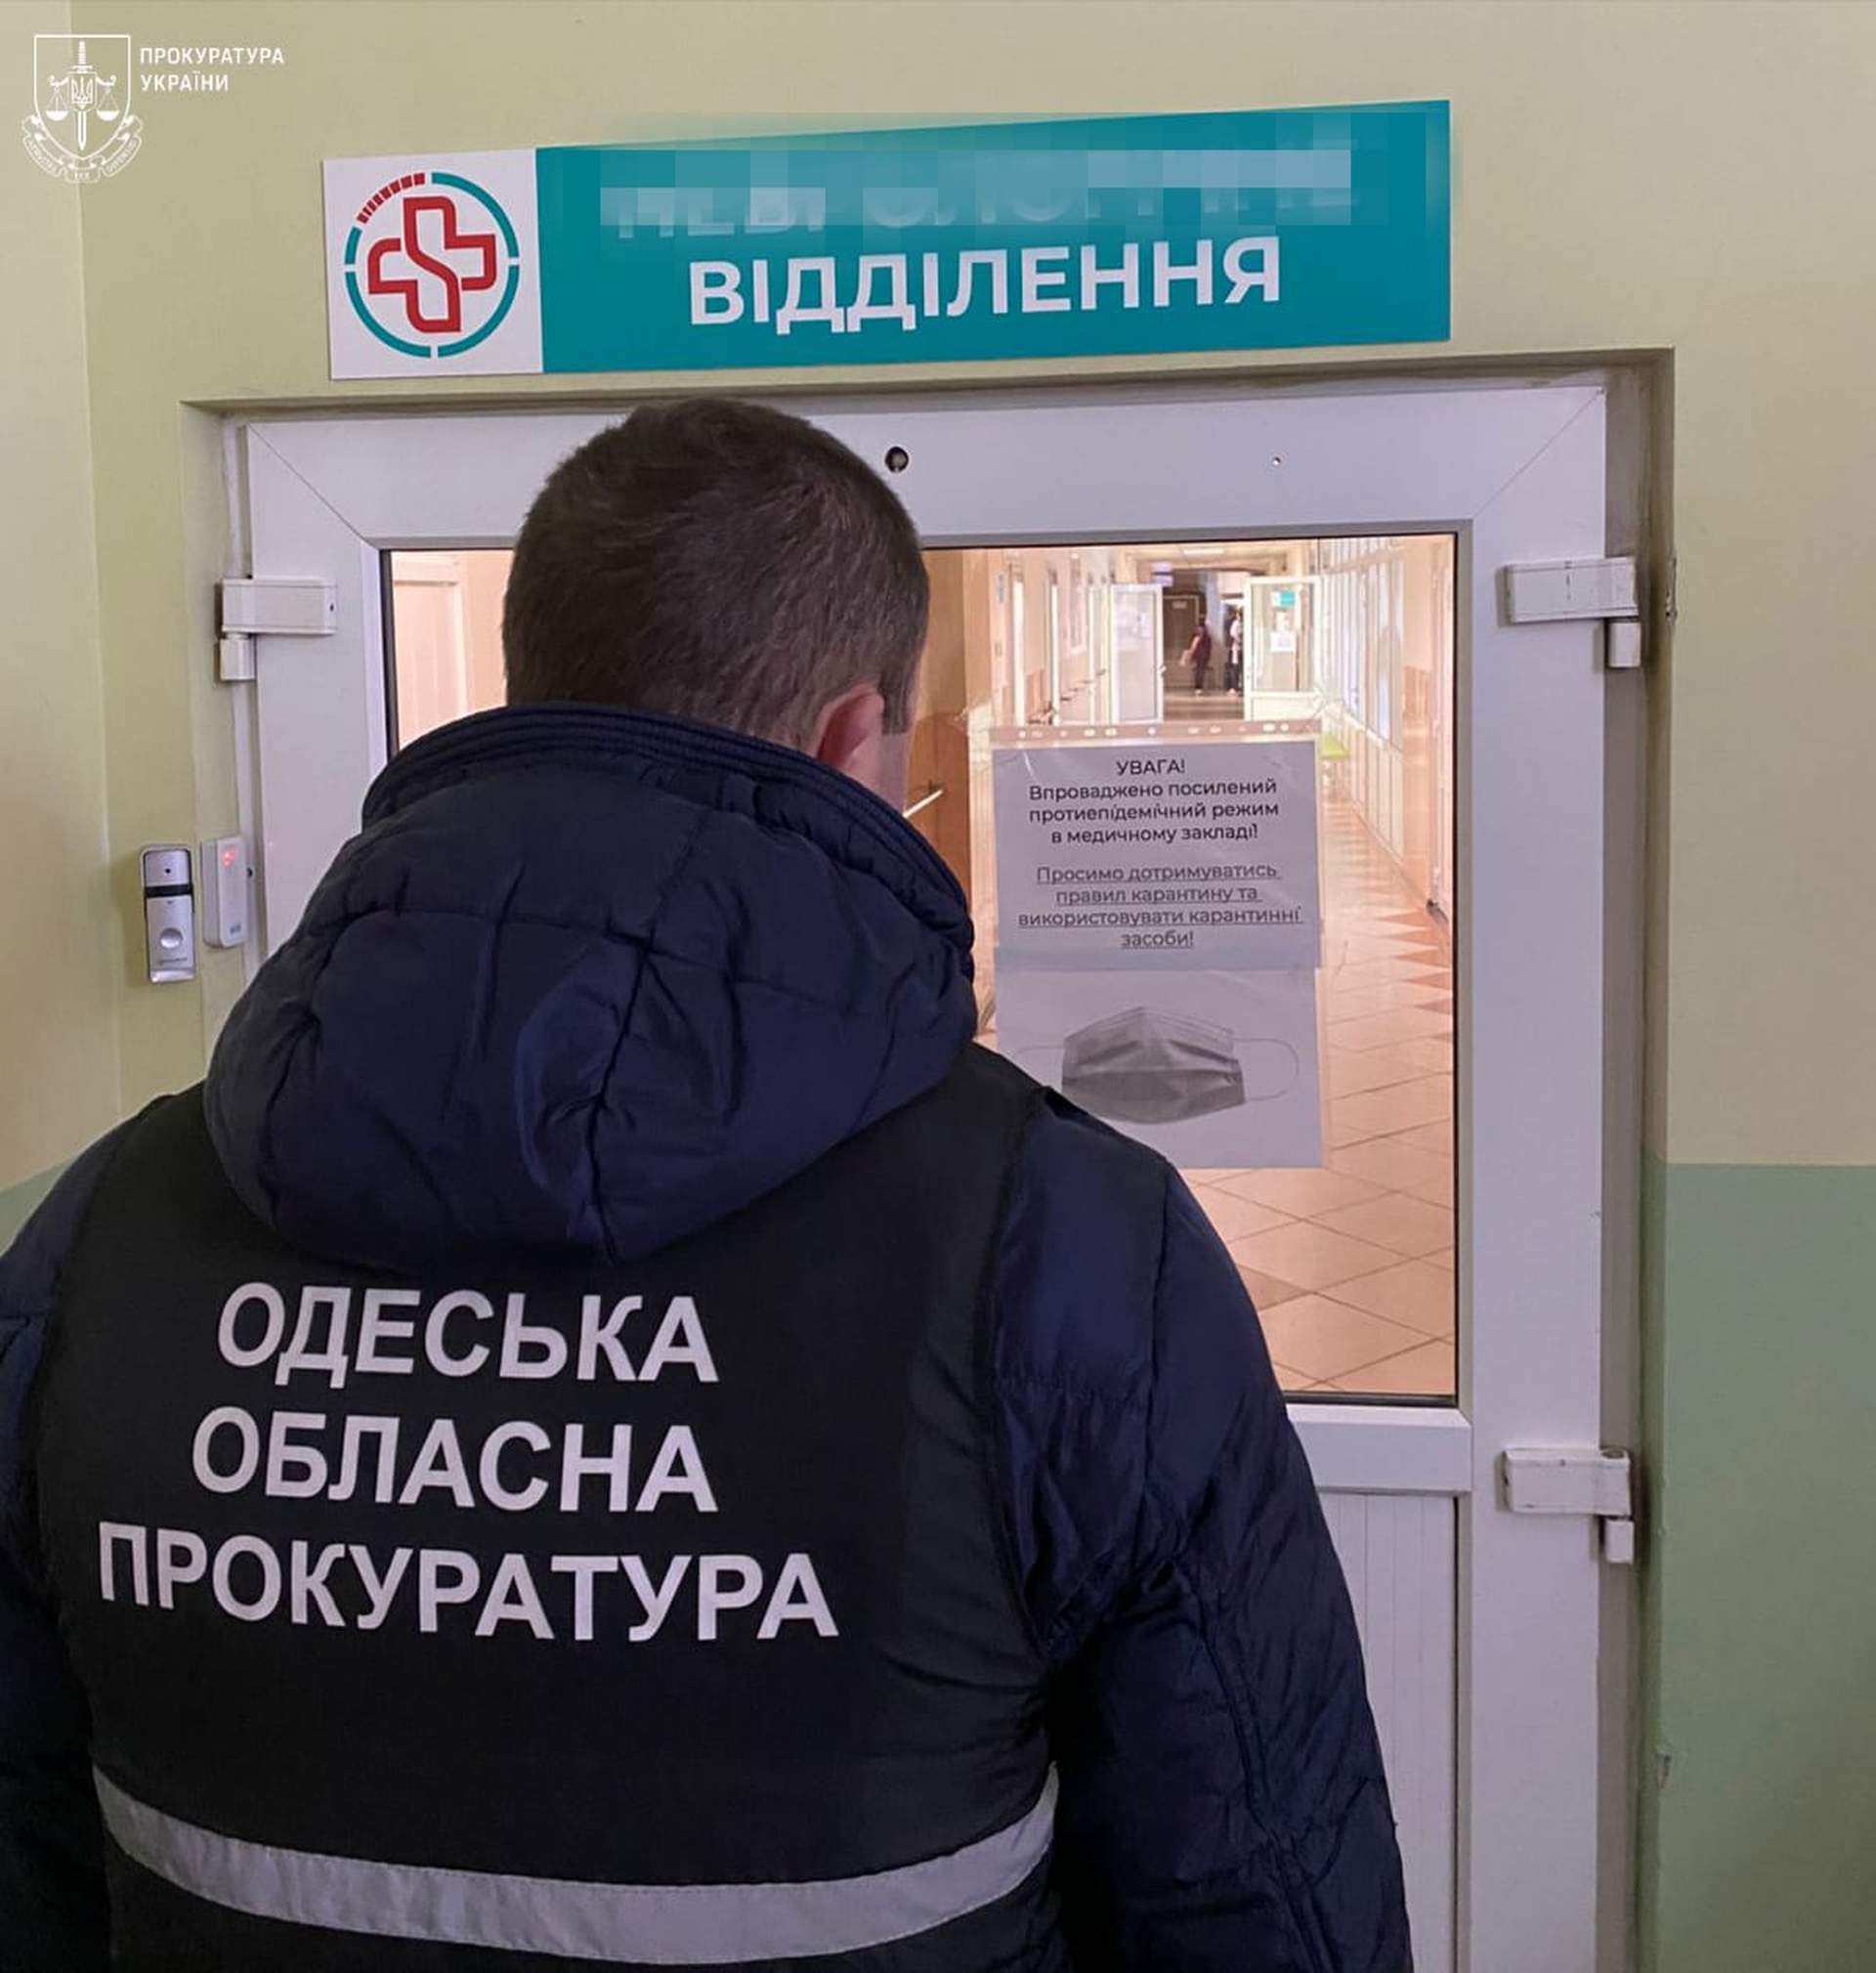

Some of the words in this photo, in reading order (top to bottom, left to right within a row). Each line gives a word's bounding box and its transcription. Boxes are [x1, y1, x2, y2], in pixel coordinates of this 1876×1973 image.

[689, 235, 1282, 336] ВІДДІЛЕННЯ
[1117, 758, 1186, 776] УВАГА!
[1029, 786, 1163, 801] Впроваджено
[1168, 780, 1276, 796] посилений
[1029, 803, 1207, 823] протиепідемічний
[1212, 804, 1279, 820] режим
[1051, 831, 1062, 843] в
[1067, 828, 1176, 843] медичному
[1181, 823, 1258, 840] закладі!
[1037, 867, 1124, 883] Просимо
[1130, 863, 1277, 880] дотримуватись
[1056, 890, 1127, 905] правил
[1131, 887, 1233, 903] карантину
[1238, 888, 1258, 901] та
[1018, 913, 1183, 926] використовувати
[1189, 907, 1300, 924] карантинні
[1121, 931, 1194, 948] засоби!
[217, 1281, 718, 1389] ОДЕСЬКА
[192, 1406, 718, 1513] ОБЛАСНА
[97, 1521, 839, 1642] ПРОКУРАТУРА
